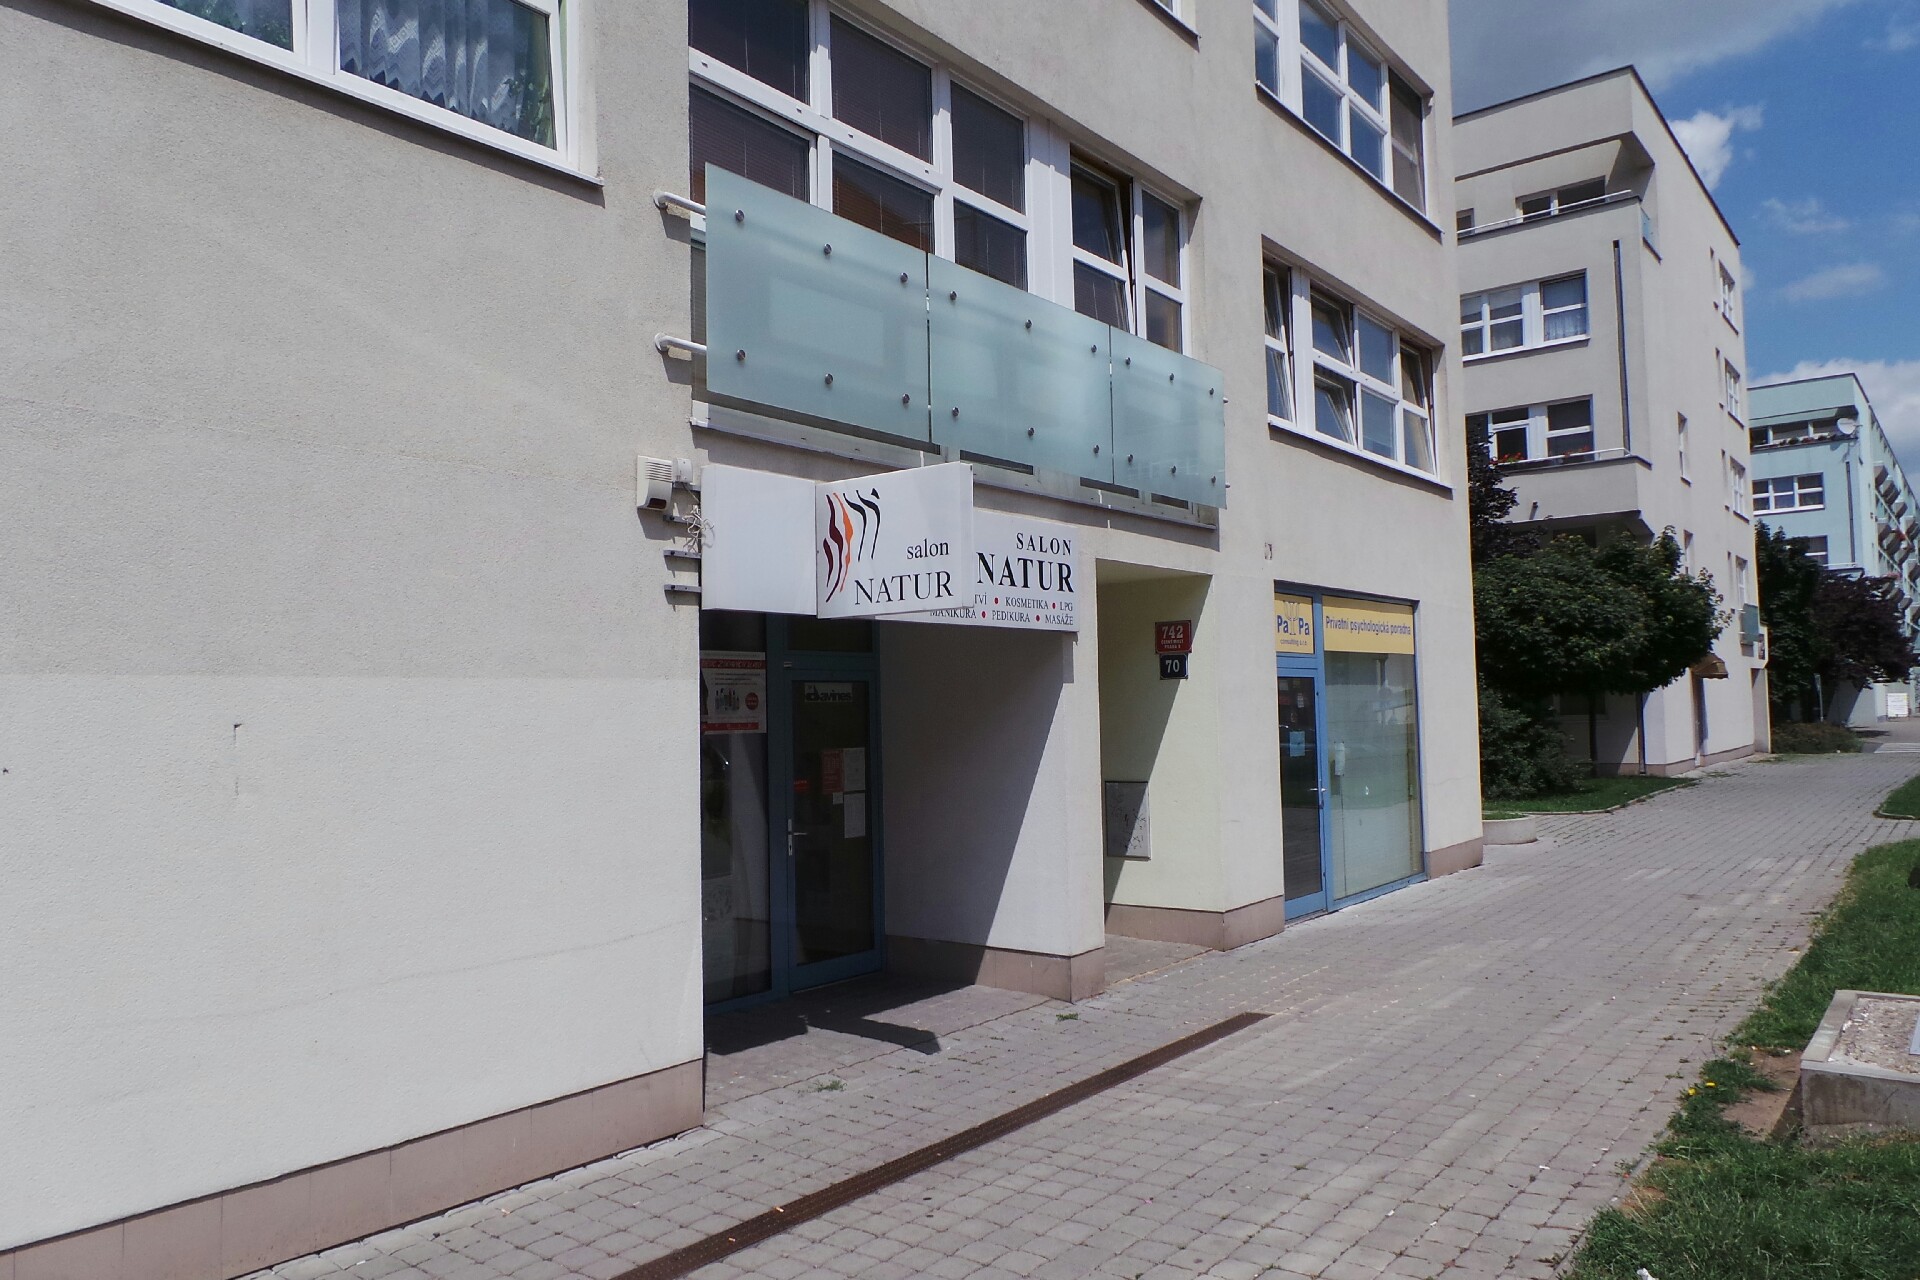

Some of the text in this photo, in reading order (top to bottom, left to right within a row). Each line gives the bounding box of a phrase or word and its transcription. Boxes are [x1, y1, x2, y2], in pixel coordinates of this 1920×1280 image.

[906, 538, 949, 560] salon
[1016, 532, 1071, 555] SALON
[976, 552, 1074, 593] NATUR
[854, 571, 954, 605] NATUR
[1005, 596, 1049, 610] KOSMETIKA
[1060, 601, 1073, 612] LPG
[992, 610, 1031, 623] PEDIKURA
[1045, 613, 1074, 626] MASÁŽE
[1162, 625, 1183, 639] 742
[1165, 659, 1180, 673] 70
